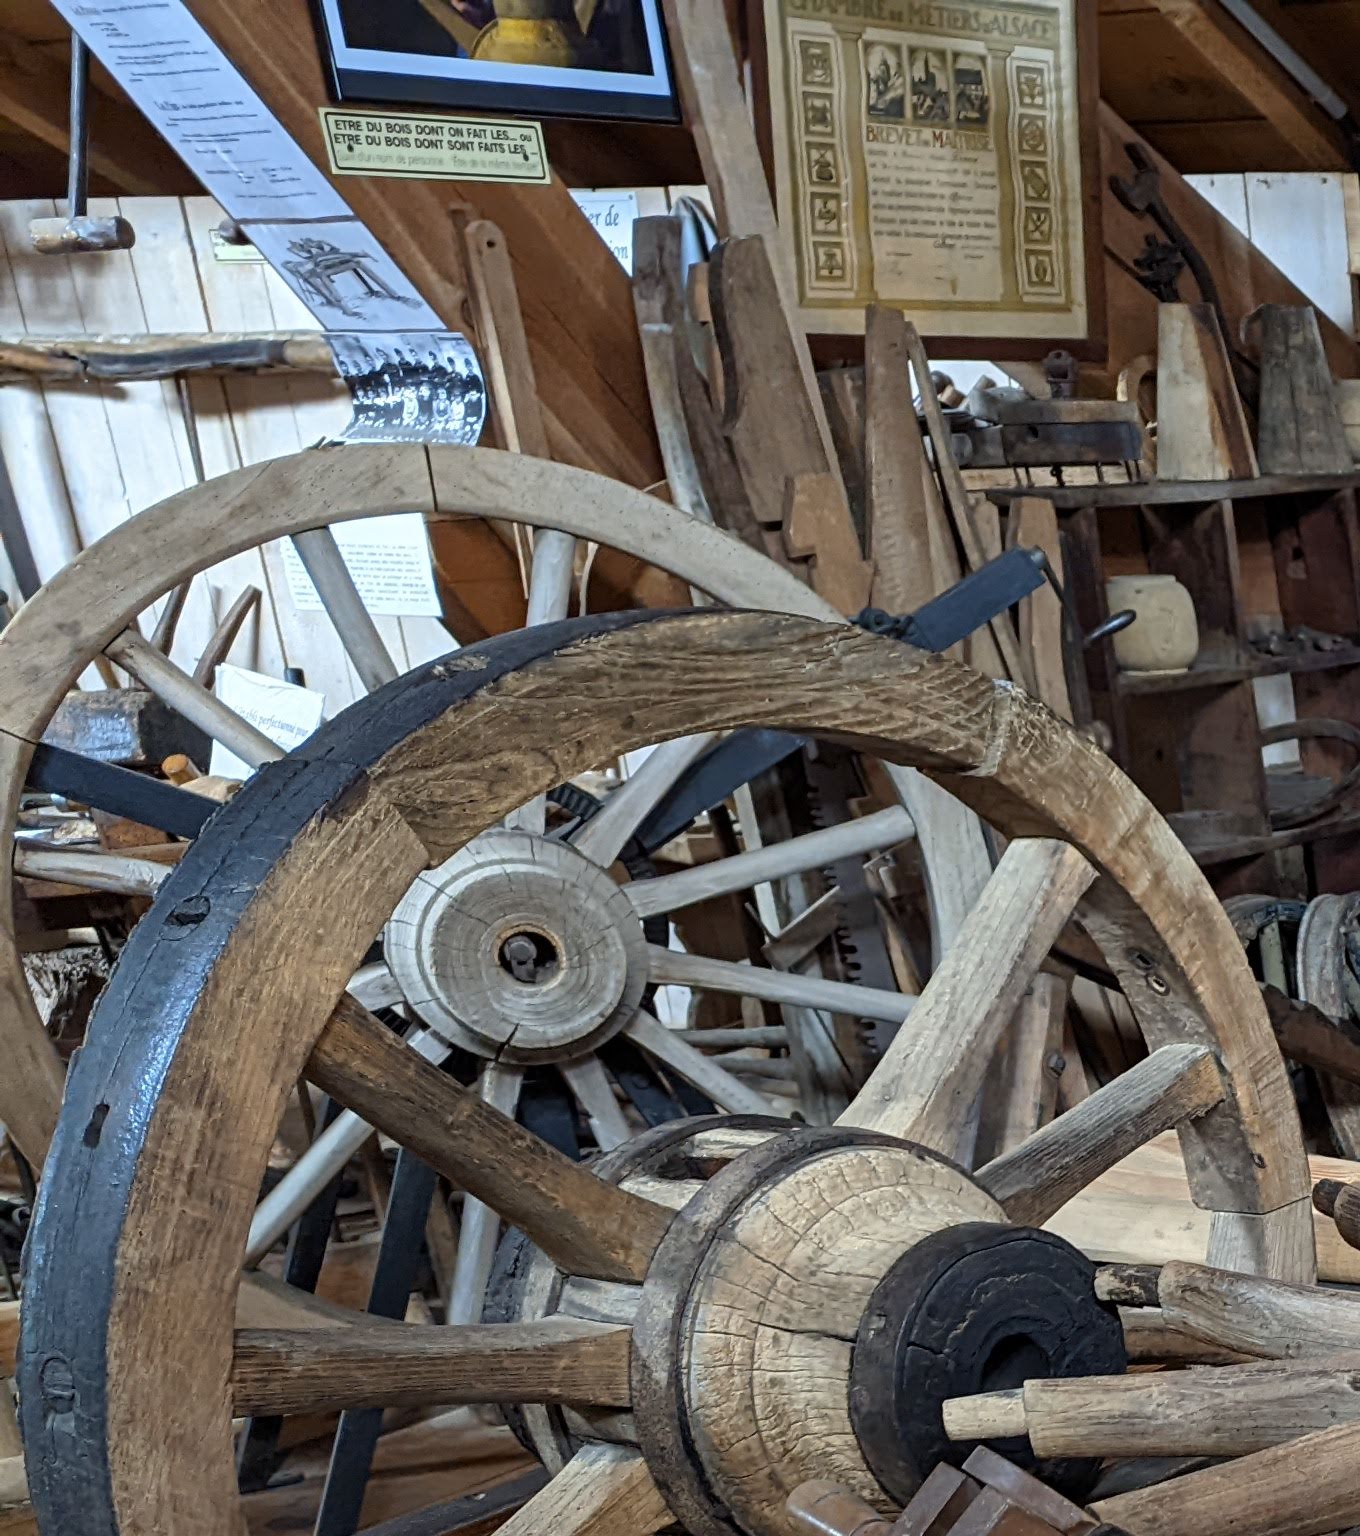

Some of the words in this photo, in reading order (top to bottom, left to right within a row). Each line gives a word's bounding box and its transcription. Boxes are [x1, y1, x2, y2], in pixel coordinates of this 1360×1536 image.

[334, 119, 363, 132] ETRE
[366, 121, 383, 133] DU
[385, 122, 413, 135] BOIS
[415, 124, 444, 137] DONT
[448, 126, 464, 138] ON
[467, 128, 487, 140] FAIT
[333, 133, 362, 146] ETRE
[365, 135, 381, 147] DU
[384, 136, 411, 149] BOIS
[414, 138, 443, 150] DONT
[447, 139, 475, 152] SONT
[478, 141, 506, 154] FAITS
[605, 204, 619, 227] de
